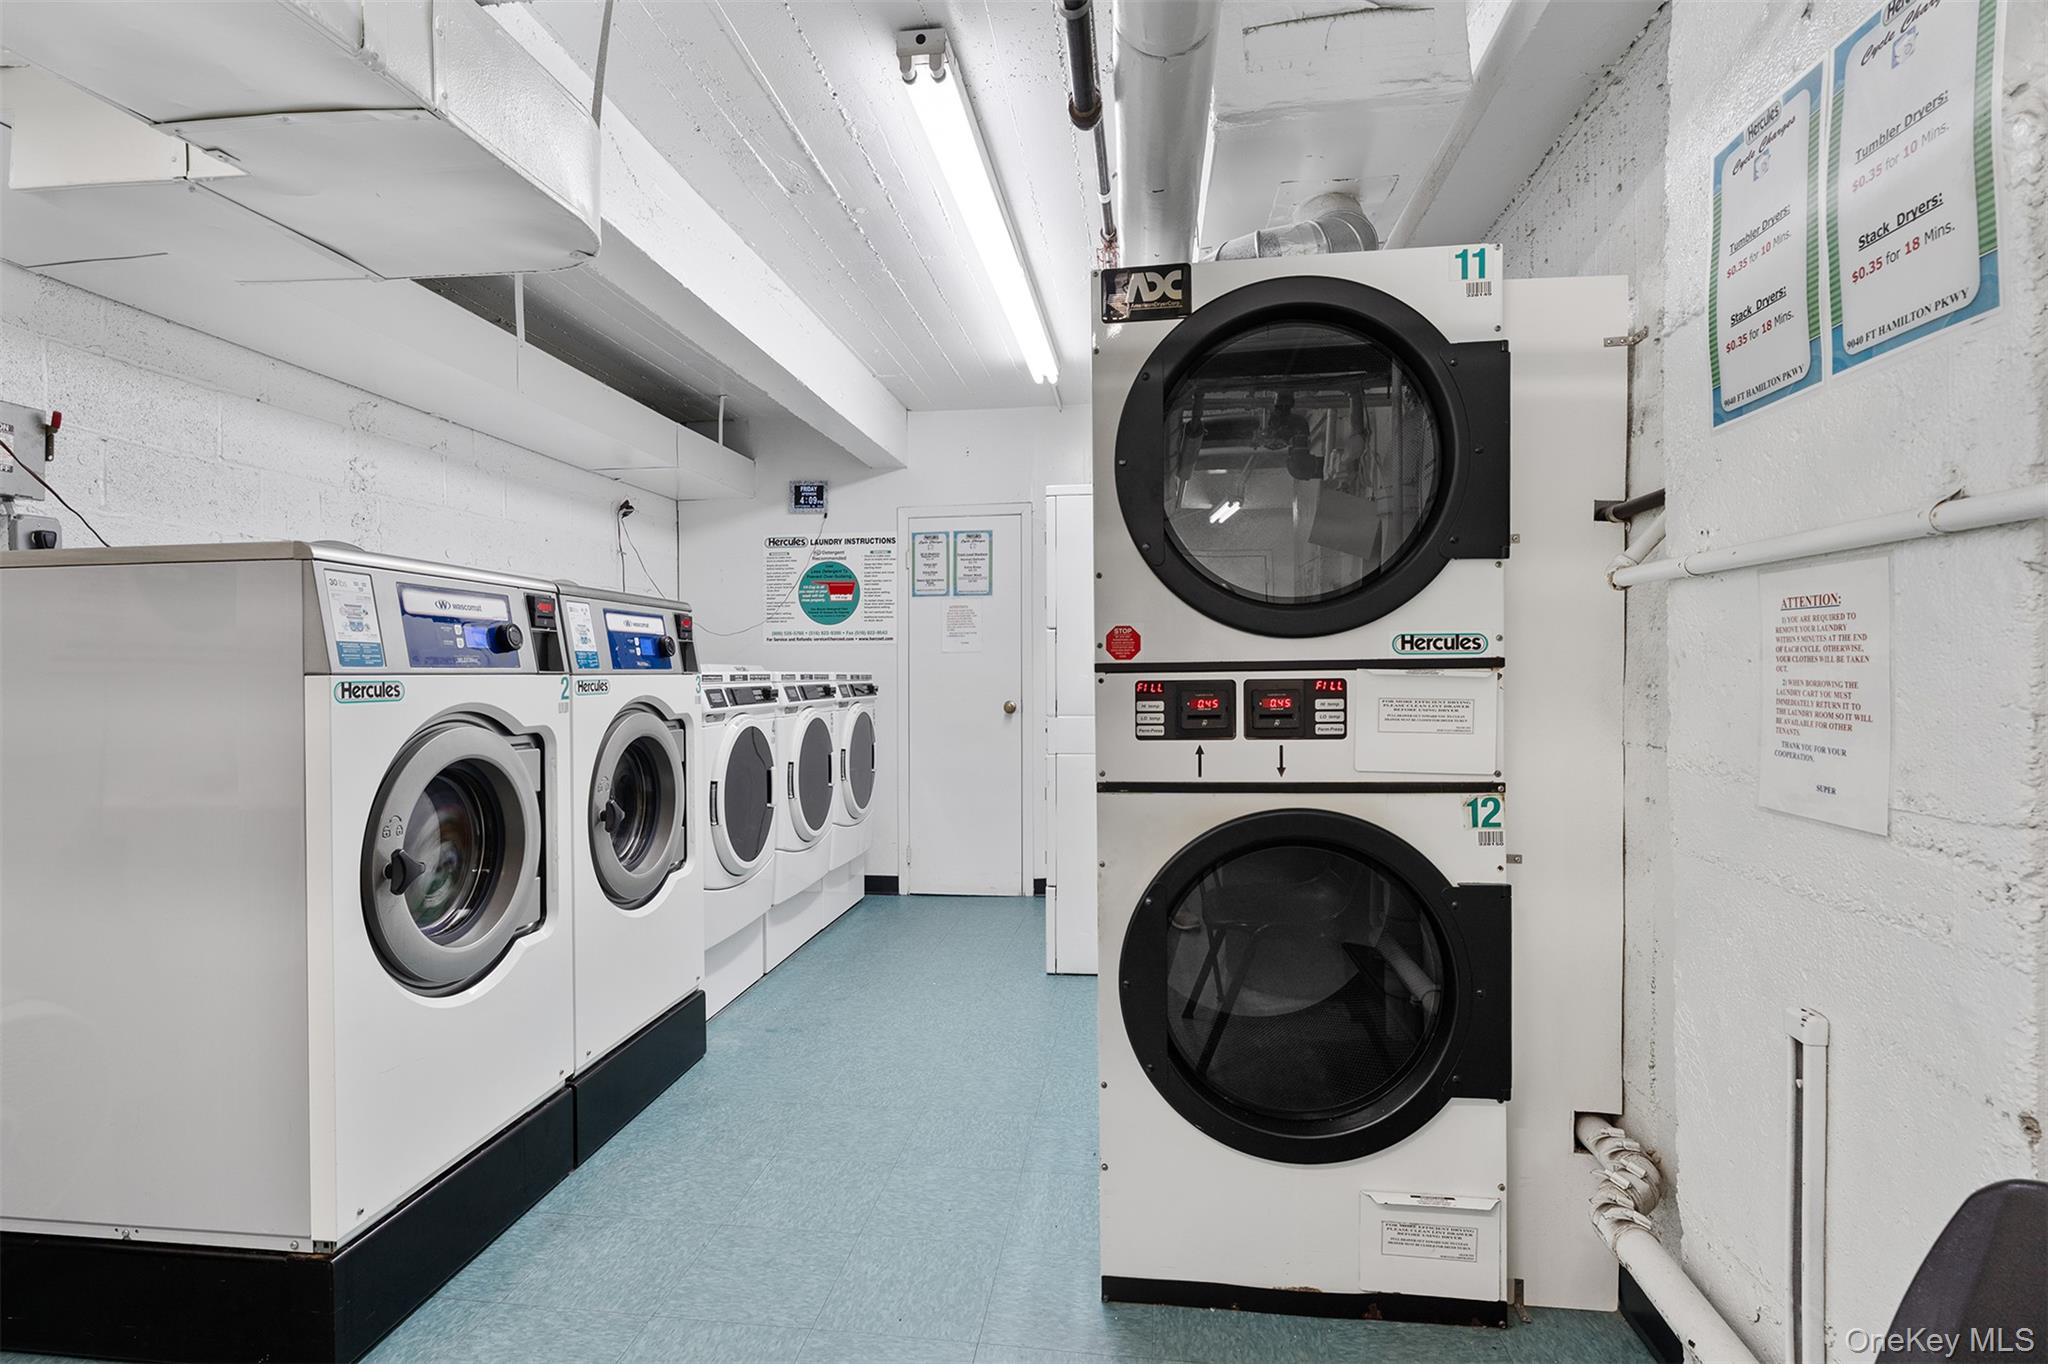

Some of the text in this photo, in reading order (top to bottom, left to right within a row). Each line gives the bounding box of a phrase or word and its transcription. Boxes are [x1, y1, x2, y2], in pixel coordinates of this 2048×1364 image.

[1747, 105, 1780, 140] Hercules
[1855, 90, 1949, 162] Tumbler Dryers:
[1852, 122, 1950, 193] $0.35 for 10 Mins.
[1858, 192, 1943, 249] Stack Dryers:
[1730, 204, 1791, 254] Tumbler Dryers:
[1726, 257, 1748, 279] $0.35
[1760, 241, 1772, 256] 10
[1852, 222, 1956, 283] $0.35 for 18 Mins.
[1455, 248, 1486, 280] 11
[1126, 269, 1182, 303] ADC
[1730, 286, 1787, 325] Stack Dryers:
[1846, 287, 1970, 350] 9040 FT HAMILTON PKWY
[1726, 310, 1795, 353] $0.35 for 18 Mins.
[1745, 374, 1781, 398] HAMILTON
[1781, 363, 1805, 382] PKWY
[800, 496, 817, 505] 4:09
[768, 537, 806, 547] Hercules
[810, 537, 897, 546] LAUNDRY INSTRUCTIONS
[329, 577, 338, 587] 30
[1781, 593, 1842, 609] ATTENTION:
[1787, 614, 1799, 624] YOU
[1800, 613, 1811, 623] ARE
[1812, 612, 1846, 623] REQUIRED
[1846, 611, 1857, 620] TO
[1775, 623, 1848, 634] REMOVE YOUR LAUNDRY
[1401, 633, 1482, 651] Hercules
[1775, 635, 1796, 644] WITHIN
[1800, 634, 1827, 643] MINUTES
[1828, 634, 1837, 642] AT
[1838, 633, 1851, 642] THE
[1853, 632, 1868, 641] END
[1775, 645, 1783, 653] OF
[1784, 645, 1799, 653] EACH
[1775, 655, 1871, 664] YOUR CLOTHES WILL BE TAKEN
[341, 681, 401, 699] Hercules
[560, 677, 569, 700] 2
[577, 680, 608, 693] Hercules
[696, 676, 701, 694] 3
[1136, 682, 1163, 694] FILL
[1315, 680, 1343, 691] FILL
[1787, 679, 1804, 687] WHEN
[1805, 679, 1844, 690] BORROWING
[1845, 680, 1858, 690] THE
[1775, 688, 1852, 700] LAUNDRY CART YOU MUST
[1775, 698, 1862, 711] IMMEDIATELY RETURN IT TO
[1775, 707, 1873, 723] THE LAUNDRY ROOM SO IT WILL
[1775, 717, 1854, 732] BE AVAILABLE FOR OTHER
[1781, 740, 1848, 757] THANK YOU FOR YOUR
[1815, 783, 1837, 795] SUPER
[1466, 796, 1502, 828] 12
